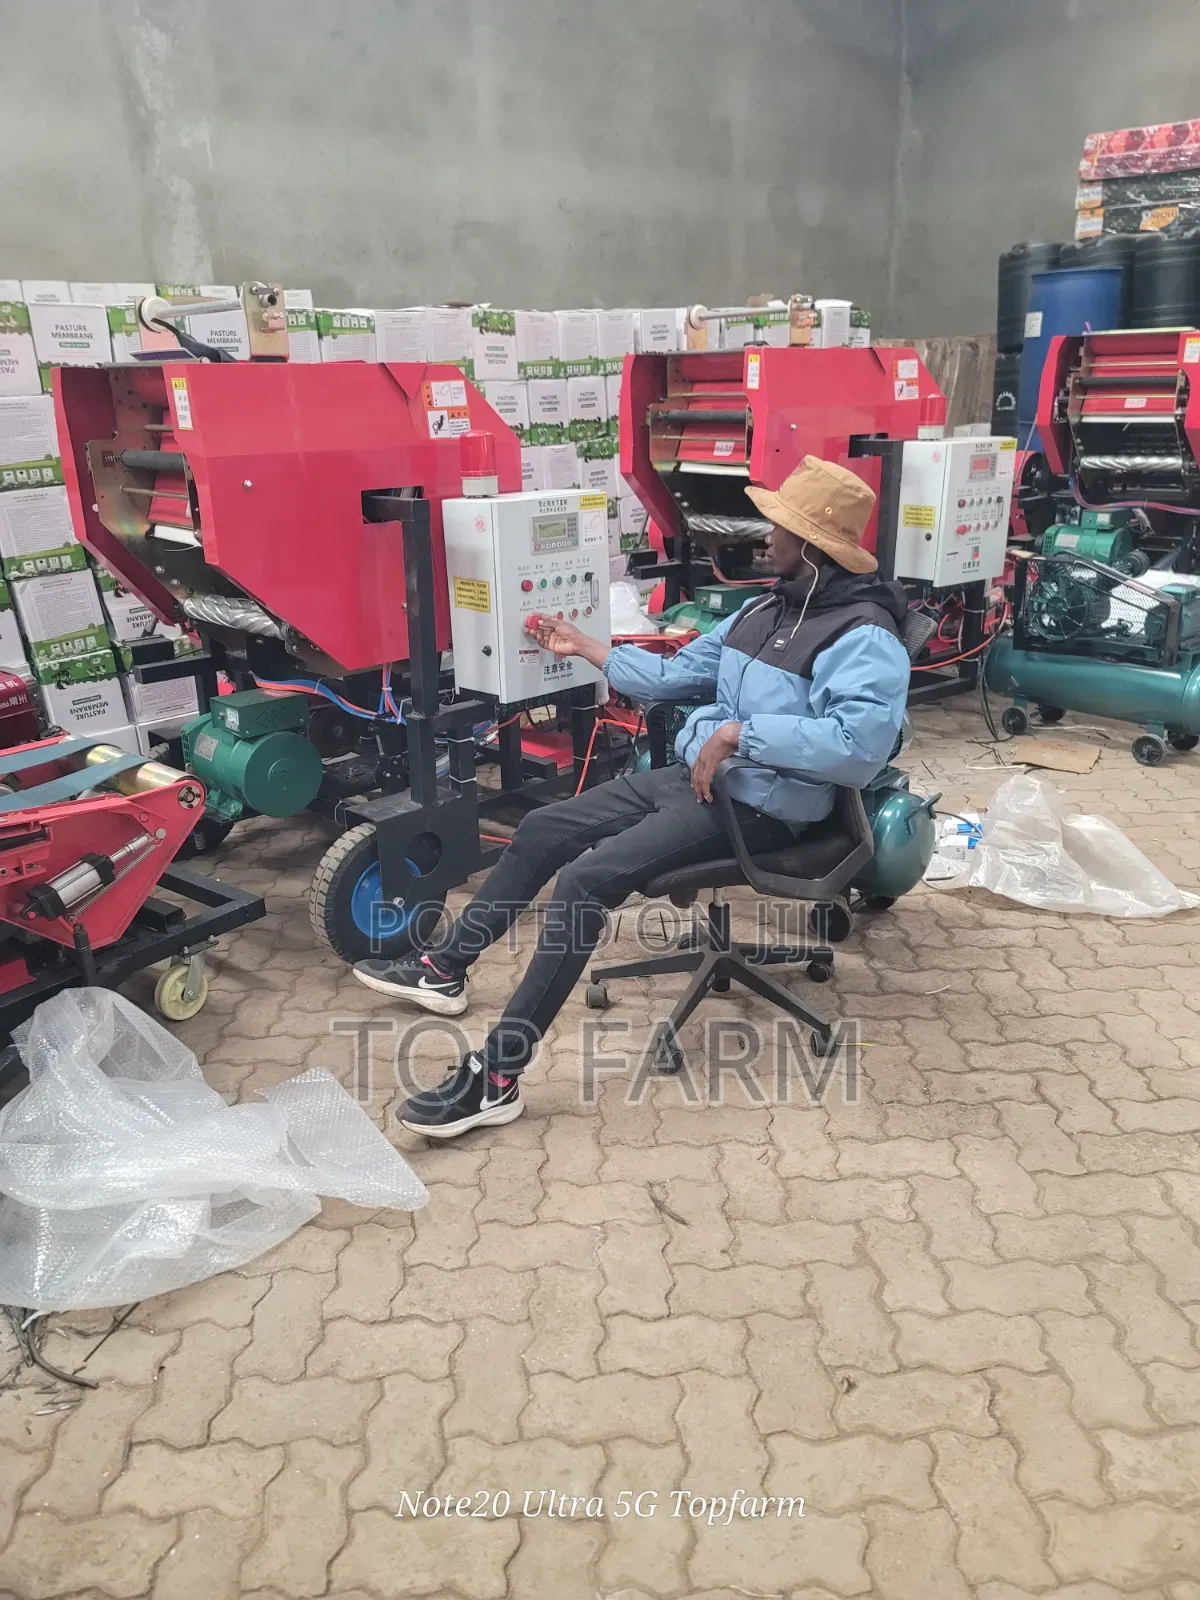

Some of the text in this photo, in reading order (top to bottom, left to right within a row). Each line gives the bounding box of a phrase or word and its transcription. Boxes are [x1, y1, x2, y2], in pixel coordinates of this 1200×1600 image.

[55, 324, 87, 332] PASTURE
[51, 332, 94, 340] MEMBRANE
[543, 660, 573, 675] 注意安全
[69, 701, 109, 715] MEMBRANE
[75, 709, 106, 721] PASTURE
